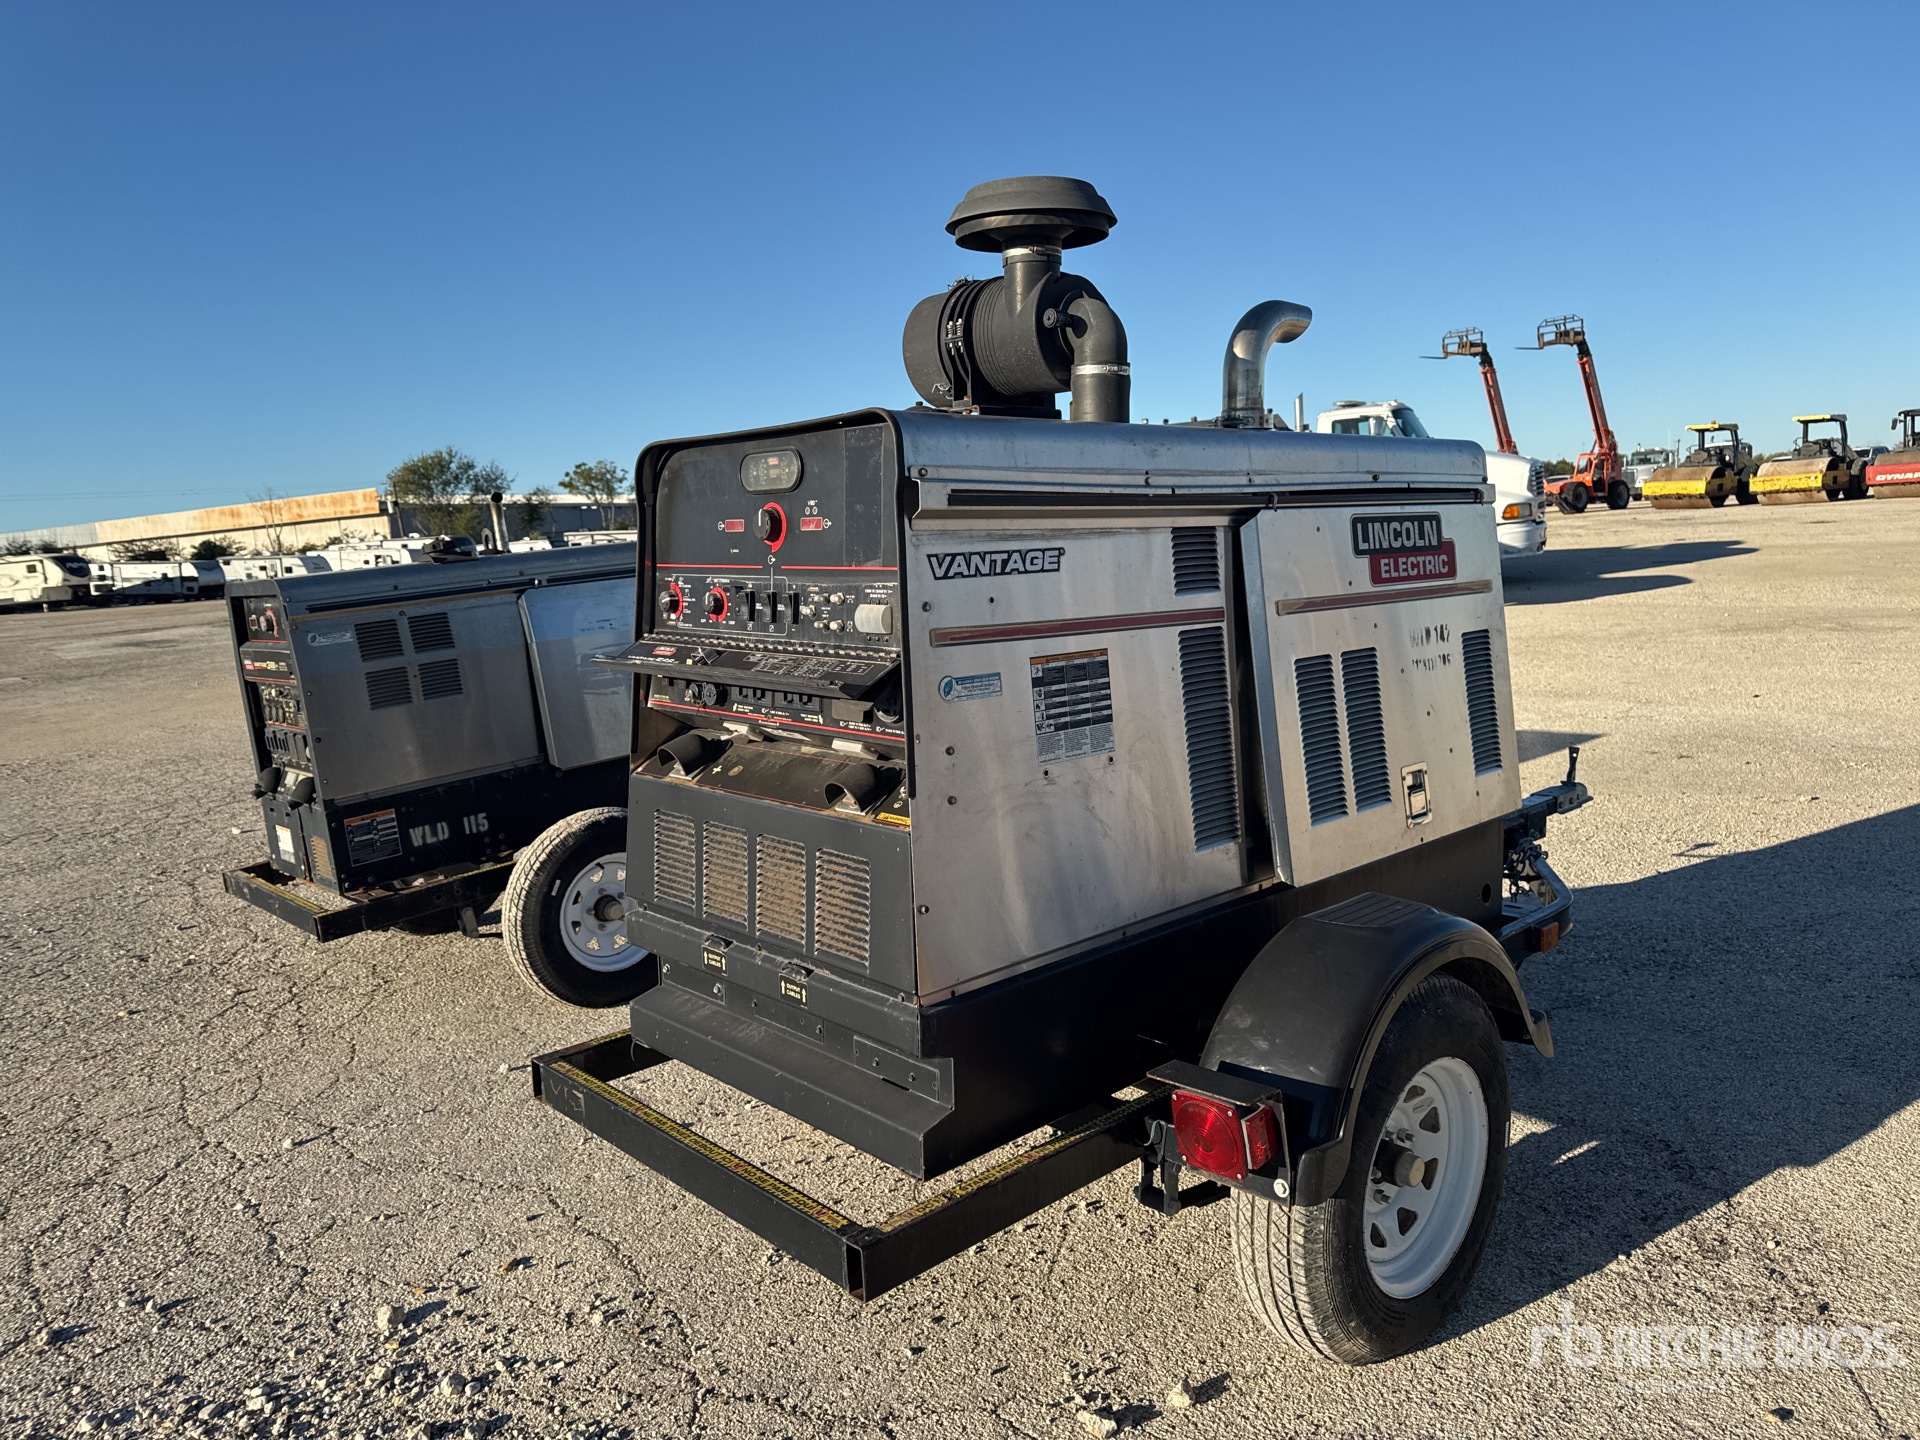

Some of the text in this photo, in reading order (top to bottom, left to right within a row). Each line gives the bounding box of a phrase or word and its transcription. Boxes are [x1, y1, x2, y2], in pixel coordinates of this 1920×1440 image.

[1357, 521, 1438, 550] LINCOLN
[926, 547, 1063, 580] VANTAGE
[1380, 554, 1449, 578] ELECTRIC
[408, 821, 450, 847] WLD
[463, 812, 489, 835] 115
[786, 983, 801, 993] OUTPUT
[594, 1083, 619, 1099] STAND
[615, 1095, 637, 1110] HERE
[689, 1137, 722, 1158] DEBOUT
[719, 1154, 734, 1165] ICI
[741, 1167, 757, 1178] NO
[754, 1174, 769, 1185] SE
[767, 1181, 794, 1199] PARE
